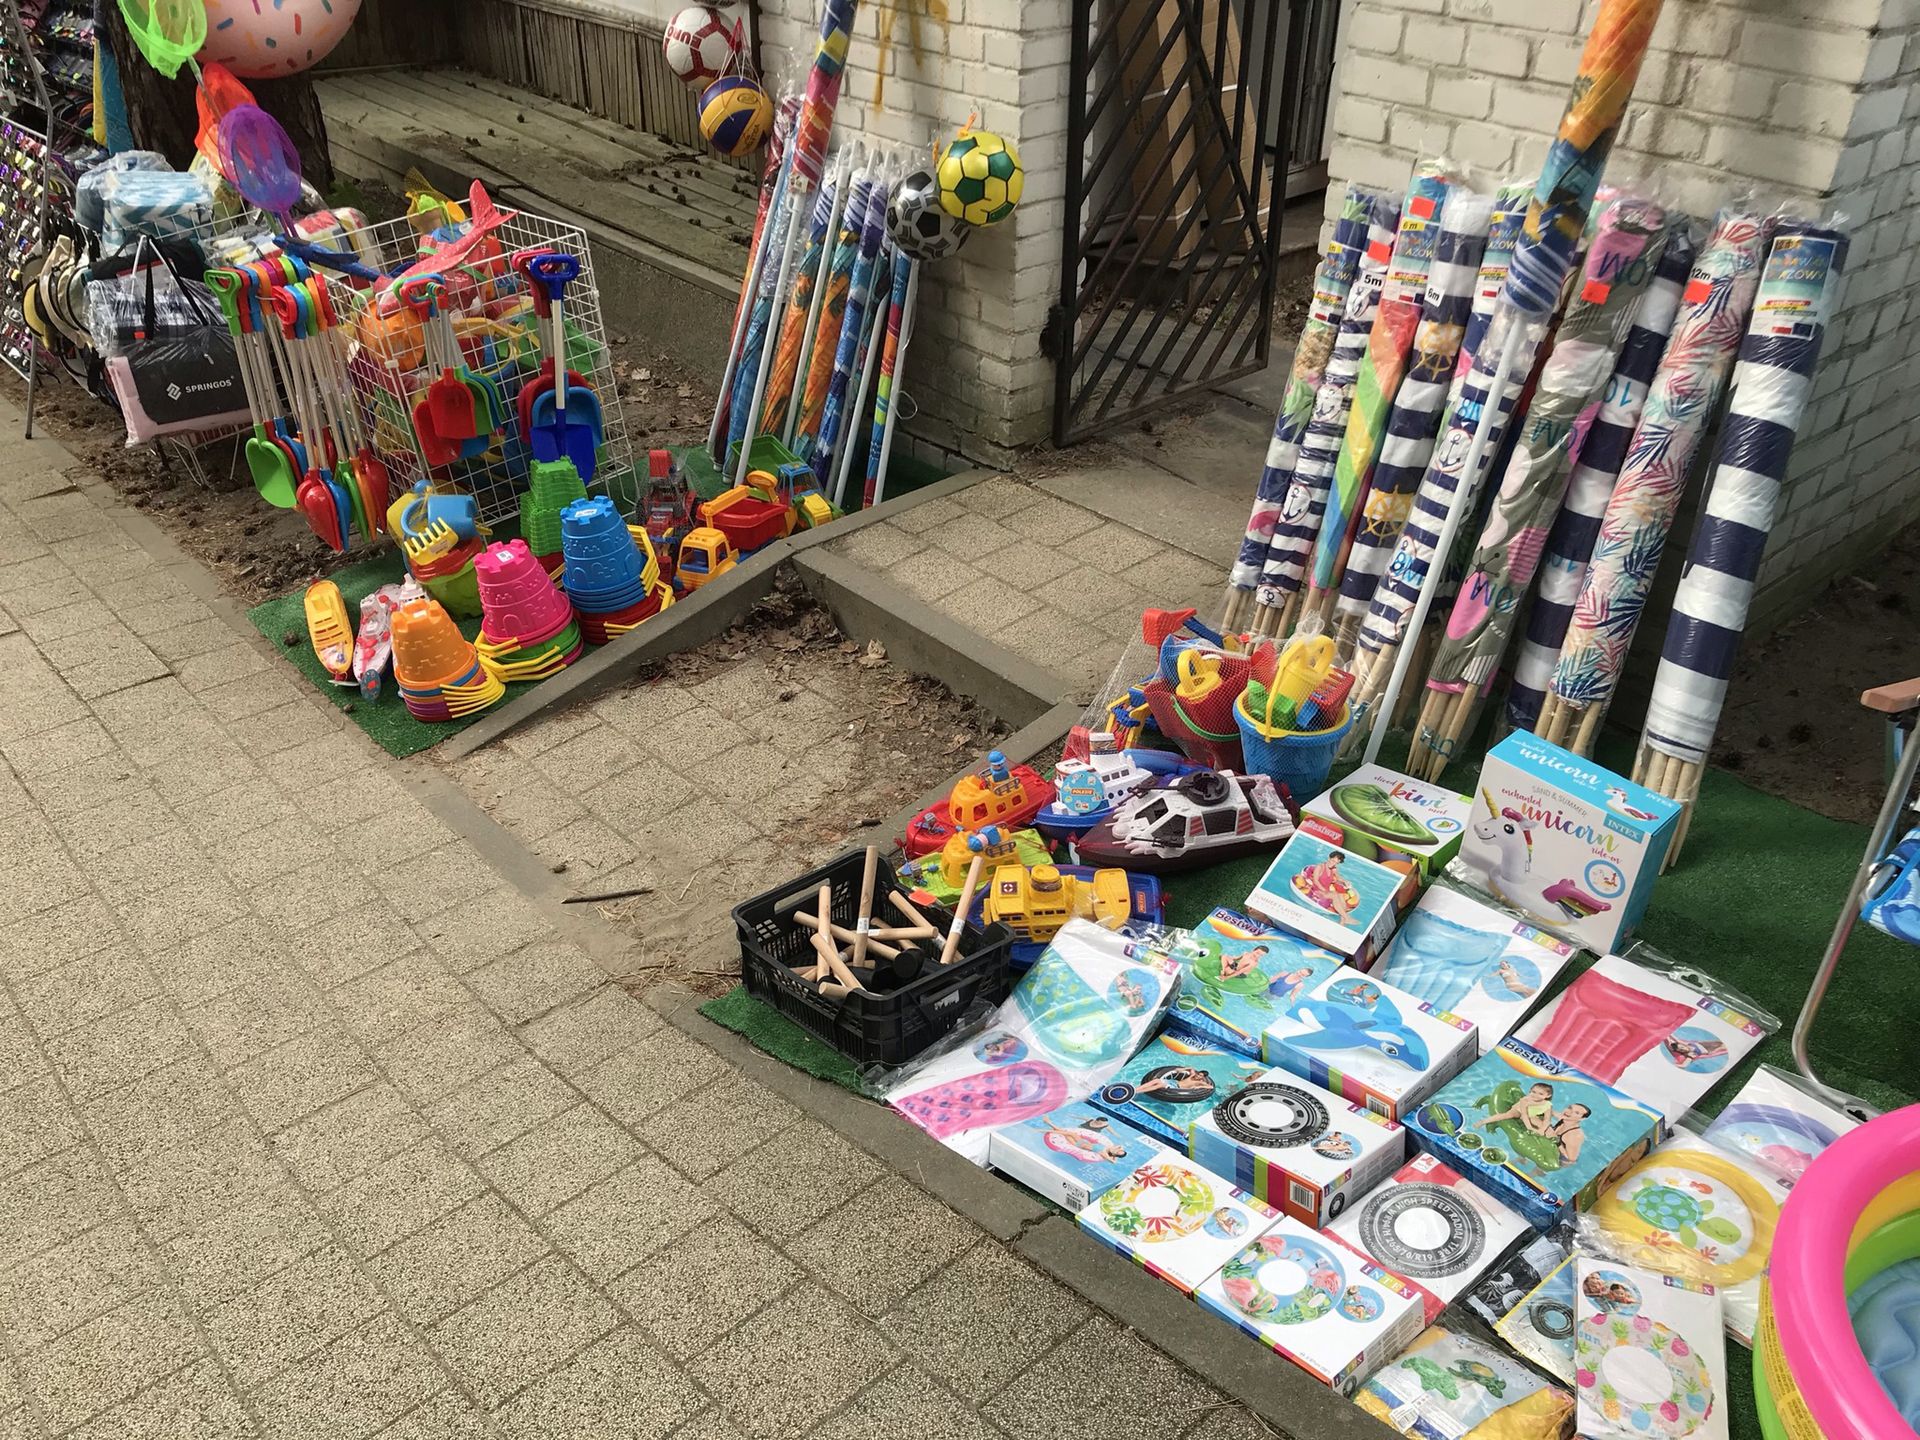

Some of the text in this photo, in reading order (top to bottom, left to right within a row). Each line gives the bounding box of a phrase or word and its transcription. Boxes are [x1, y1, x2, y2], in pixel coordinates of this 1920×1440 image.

[1364, 274, 1382, 287] 5m
[1691, 267, 1711, 281] 12m
[1427, 287, 1440, 301] 6m
[185, 379, 232, 394] SPRINGOS
[1519, 747, 1602, 785] unicorn
[1390, 782, 1448, 809] kiwi
[1501, 787, 1543, 808] enchanted
[1532, 784, 1551, 797] SAND
[1558, 794, 1589, 818] SUMMER
[1307, 820, 1341, 841] Bestway
[1521, 802, 1620, 853] unicorn
[1606, 819, 1641, 841] INTEX
[1591, 846, 1623, 865] ride-on
[1214, 909, 1265, 937] Bestway
[1513, 922, 1570, 955] INTEX
[1419, 1003, 1472, 1031] INTEX
[1698, 998, 1764, 1035] INTEX
[1504, 1040, 1562, 1075] Bestway
[1348, 1102, 1399, 1131] INTEX
[1230, 1188, 1278, 1218] INTEX
[1395, 1197, 1464, 1258] HIGH SPEED RADIAL TYRE
[1361, 1264, 1415, 1299] INTEX
